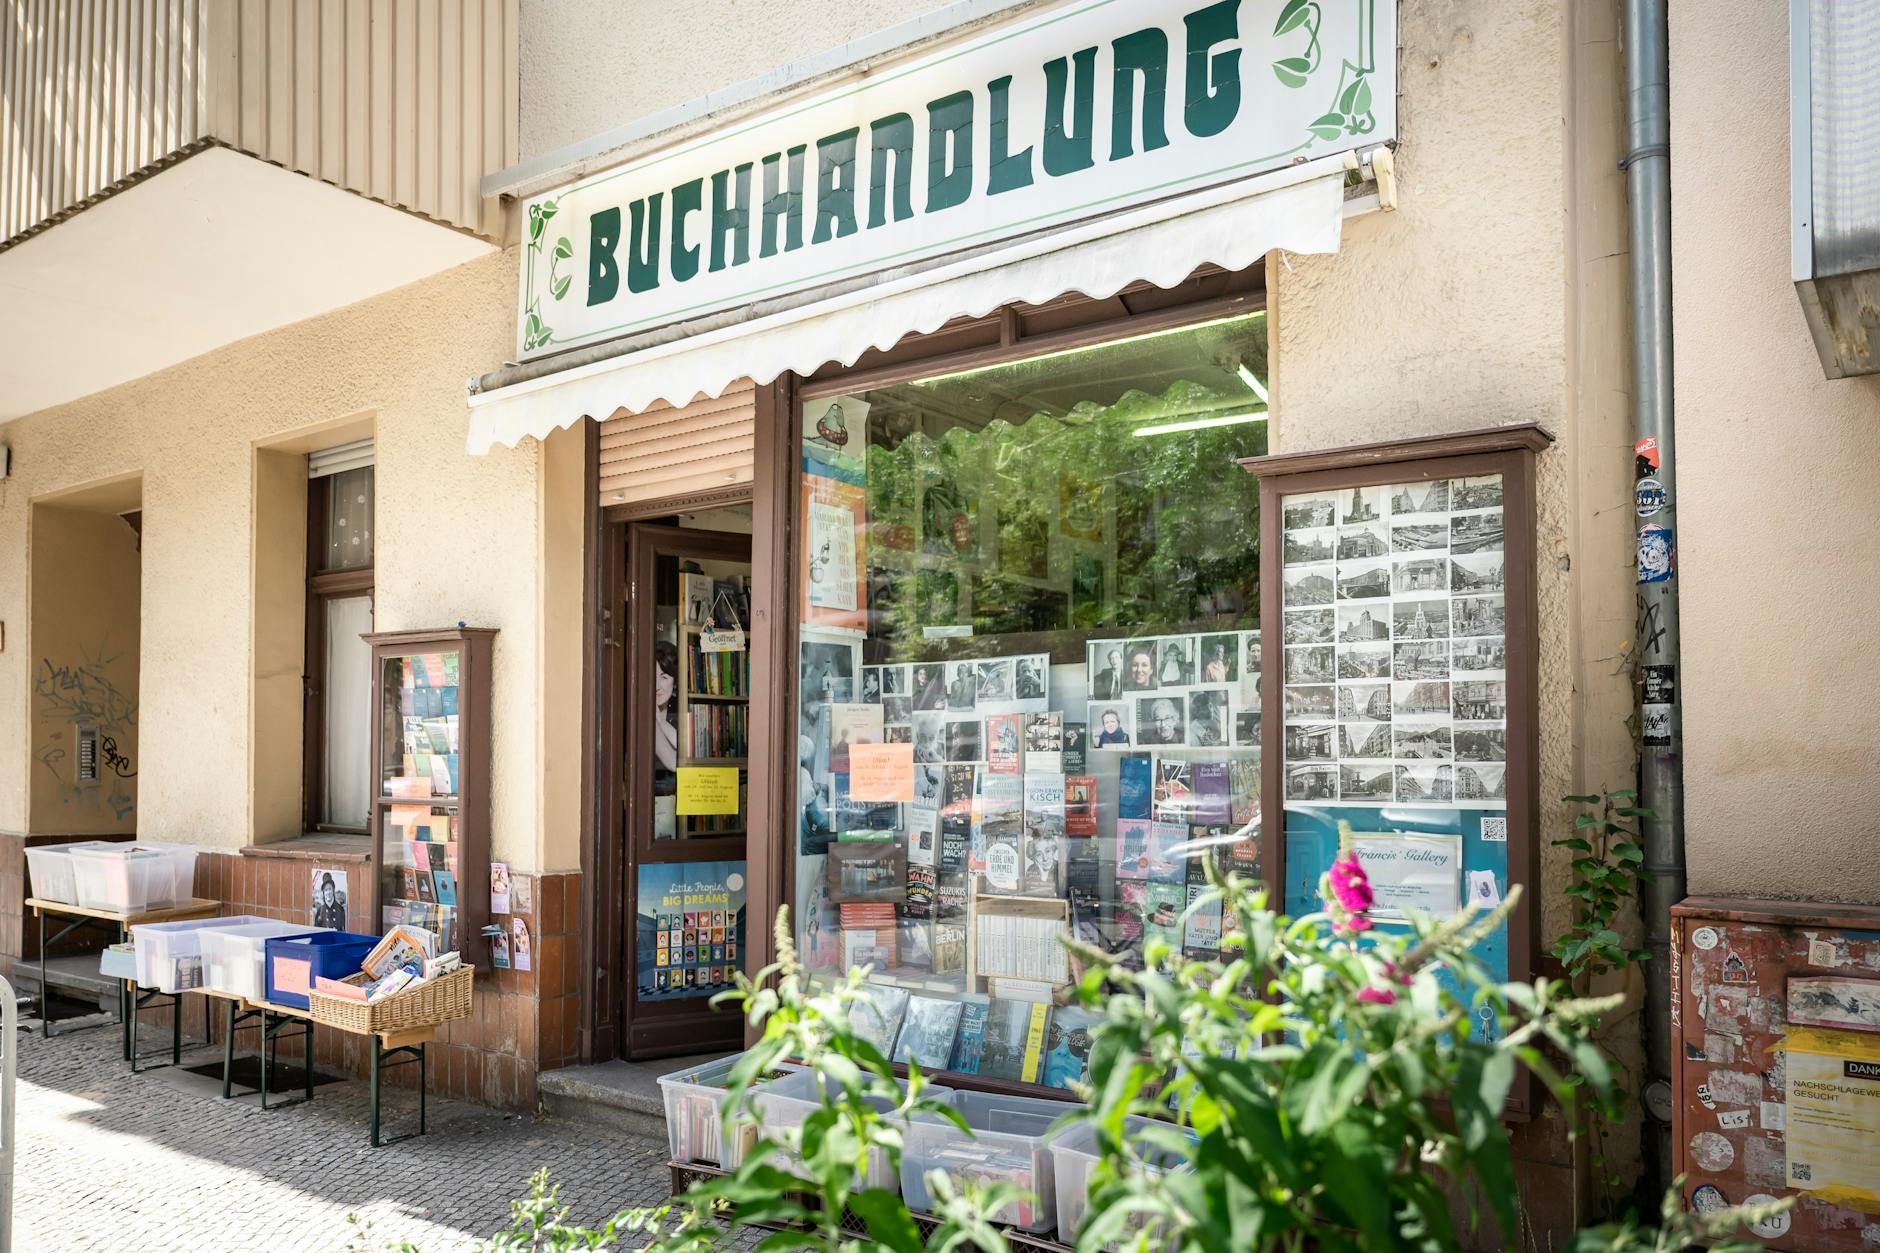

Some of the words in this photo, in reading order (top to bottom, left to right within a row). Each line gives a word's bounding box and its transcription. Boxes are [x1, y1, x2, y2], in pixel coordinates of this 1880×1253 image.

[586, 0, 1242, 307] BUCHHANDLUNG
[1029, 793, 1061, 802] KISCH
[943, 840, 962, 849] NOCH
[943, 849, 967, 858] WACH?
[989, 854, 1002, 864] ERDE
[1003, 855, 1015, 864] UND
[1404, 848, 1448, 865] Gallery
[990, 864, 1013, 874] HIMMEL
[908, 871, 934, 884] WAHN
[669, 883, 693, 893] Little
[694, 882, 725, 893] People,
[940, 886, 966, 896] SUZUKIS
[663, 896, 682, 906] BIG
[684, 893, 728, 905] DREAMS
[942, 896, 964, 907] RACHE
[936, 927, 965, 944] BERLIN
[1849, 1062, 1880, 1076] DANK
[1793, 1089, 1840, 1102] GESUCHT
